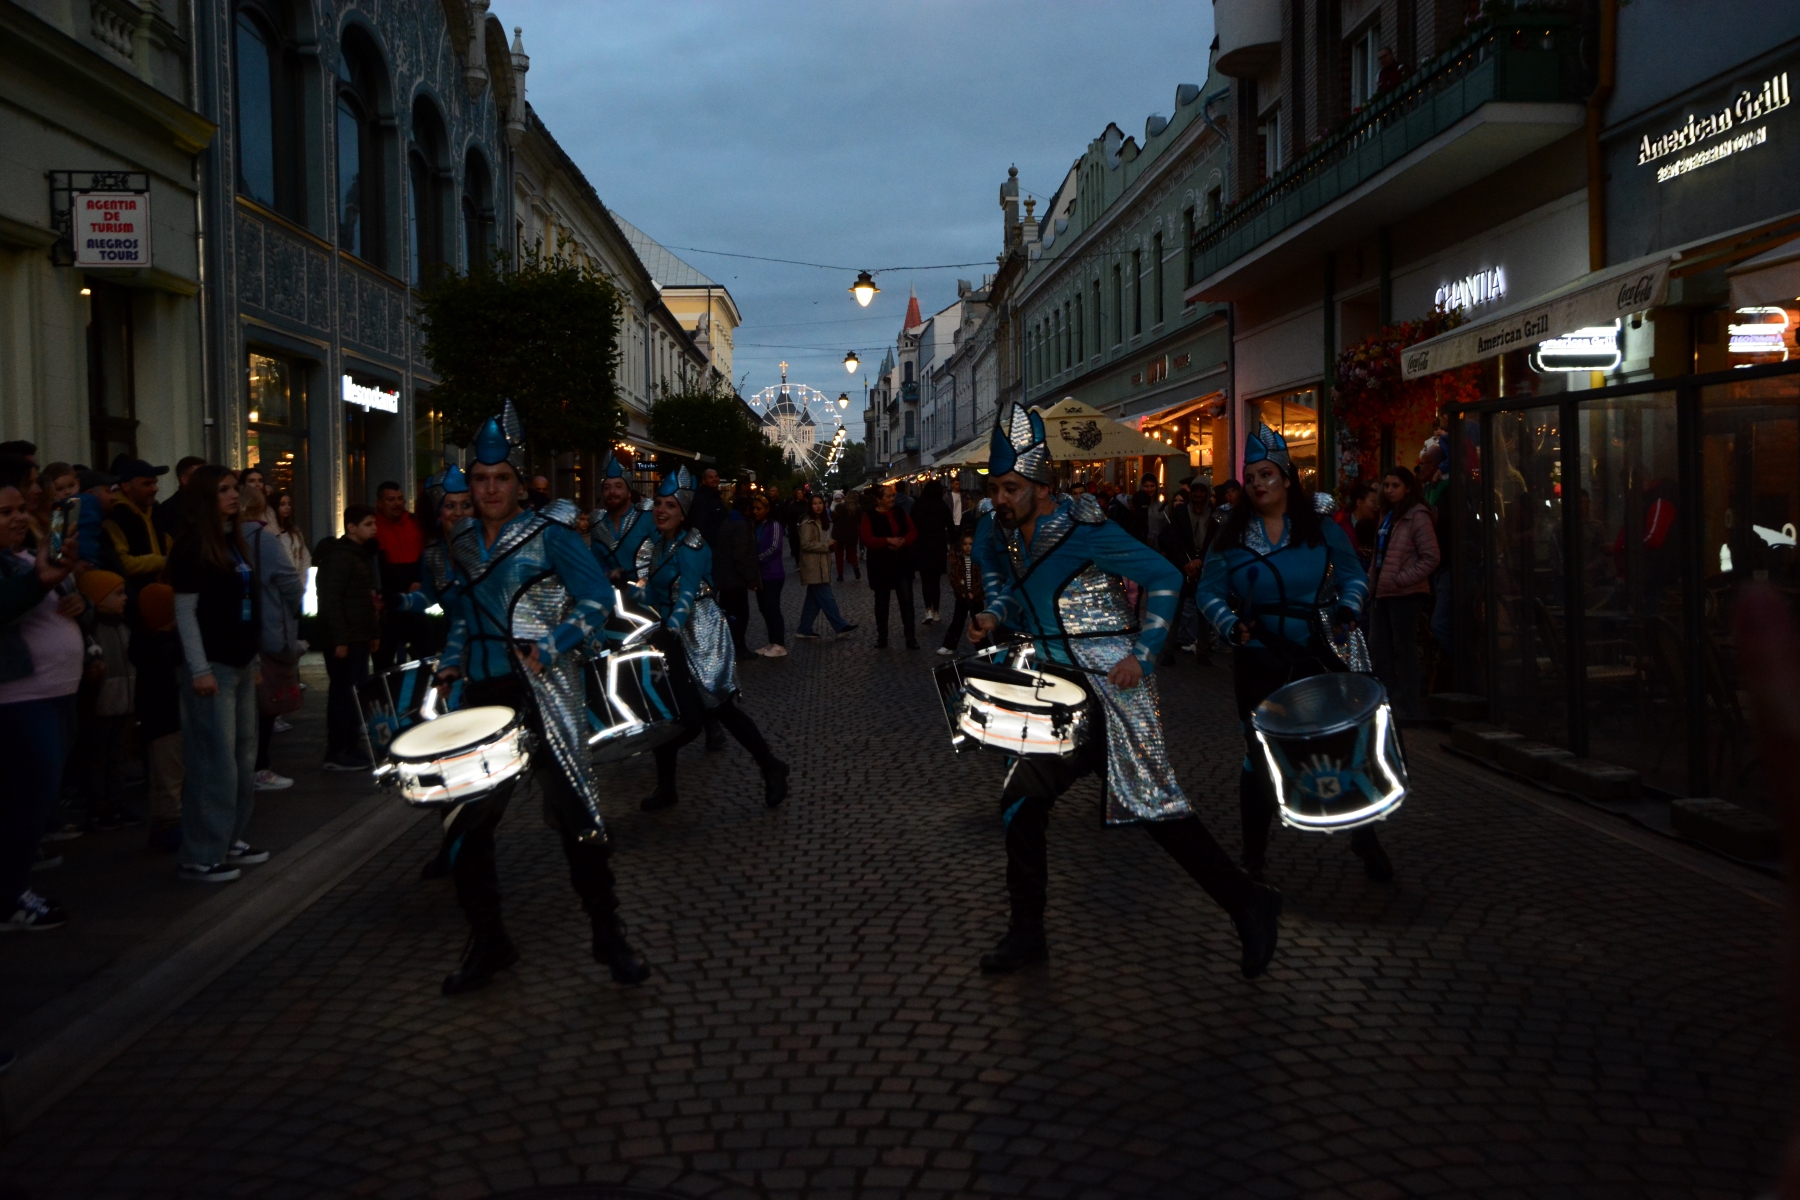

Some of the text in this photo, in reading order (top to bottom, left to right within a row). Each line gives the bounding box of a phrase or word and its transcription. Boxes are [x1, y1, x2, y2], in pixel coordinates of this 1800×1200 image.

[1637, 72, 1791, 166] American Grill
[86, 200, 137, 210] AGENTIA
[104, 212, 120, 221] DE
[90, 223, 134, 233] TURISM
[87, 239, 139, 249] ALEGROS
[99, 250, 139, 261] TOURS
[1435, 266, 1505, 314] CHANTIA
[1478, 314, 1549, 354] American Grill
